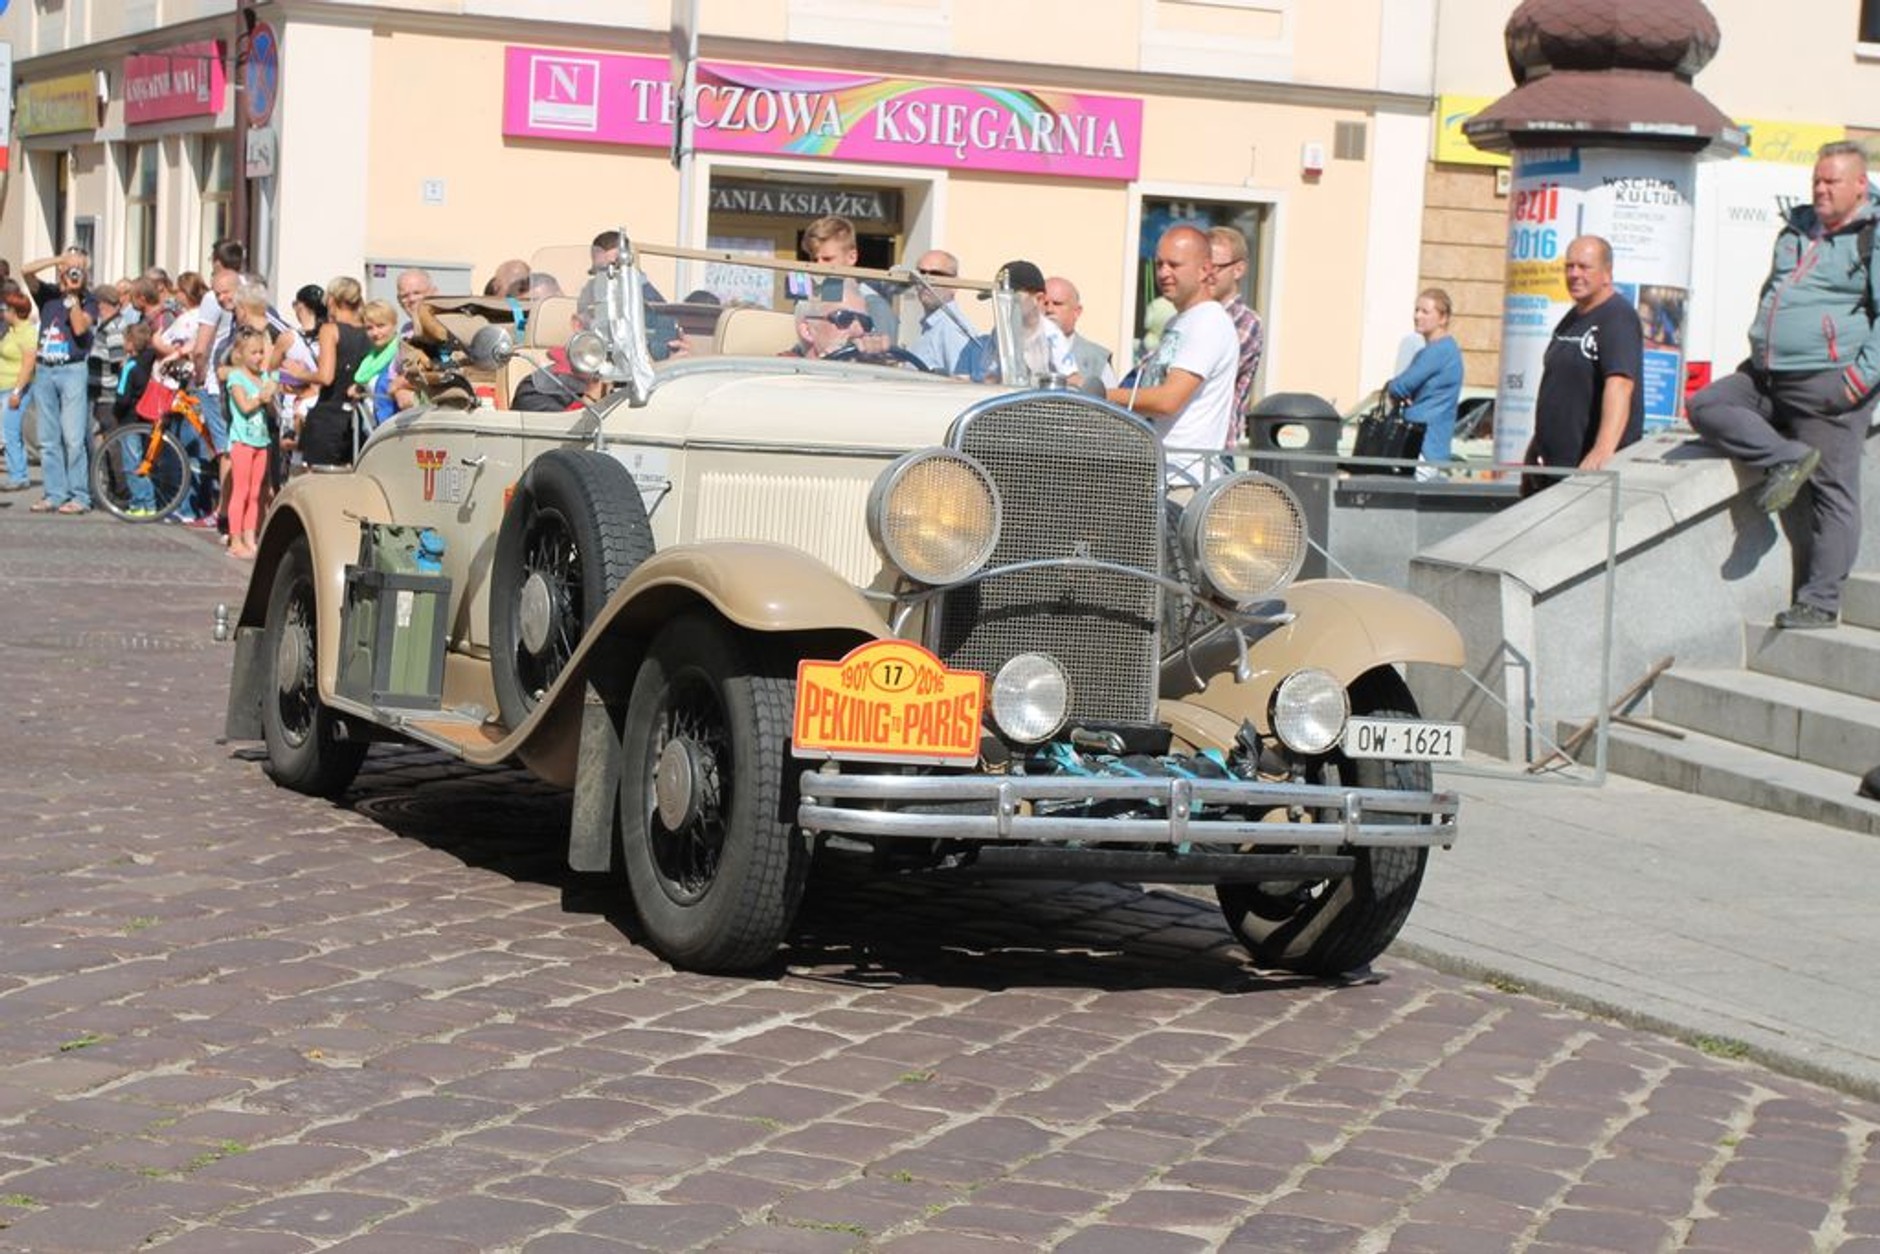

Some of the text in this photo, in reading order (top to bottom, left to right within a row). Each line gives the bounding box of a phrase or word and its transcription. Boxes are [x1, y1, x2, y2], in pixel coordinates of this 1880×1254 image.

[547, 64, 579, 101] N
[874, 99, 1124, 160] KSIĘGARNIA
[1511, 227, 1557, 260] 2016
[840, 661, 945, 696] 1907 17 2016
[802, 680, 891, 744] PEKING
[903, 691, 976, 748] PARIS
[1403, 727, 1453, 756] 1621
